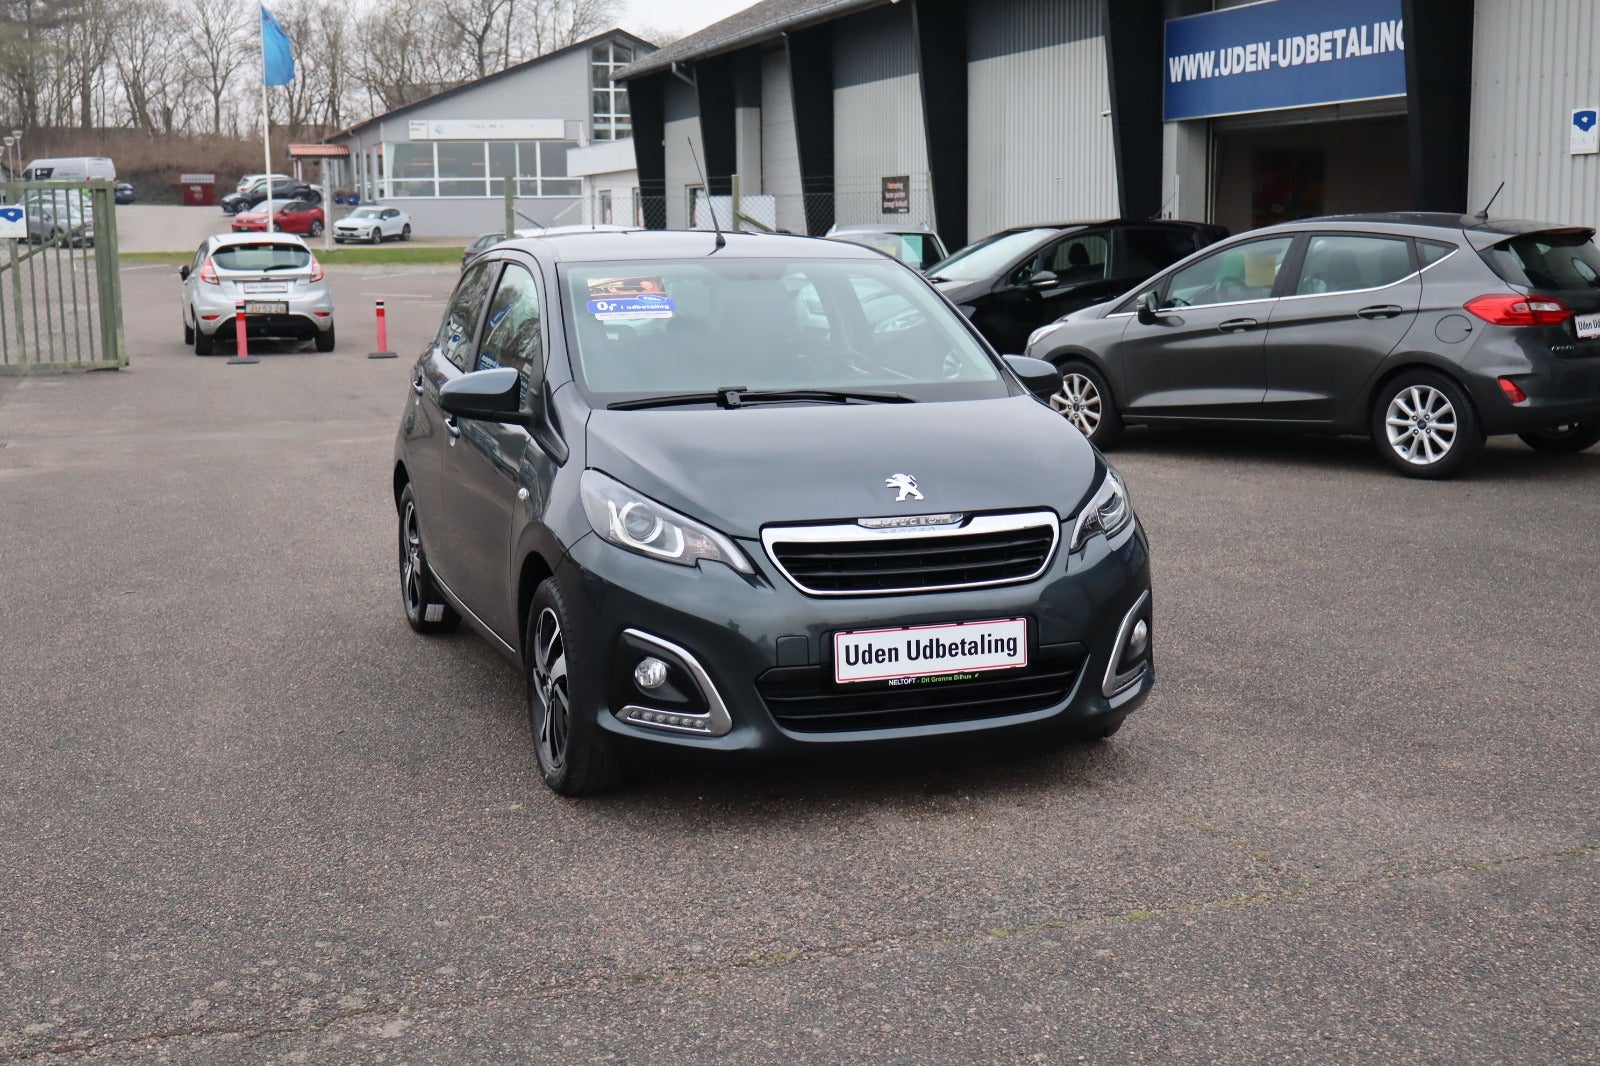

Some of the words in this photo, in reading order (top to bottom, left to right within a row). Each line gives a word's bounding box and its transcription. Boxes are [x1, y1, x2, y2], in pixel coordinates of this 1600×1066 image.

[845, 643, 899, 666] Uden
[906, 634, 1018, 661] Udbetaling
[888, 677, 917, 686] NELTOFT
